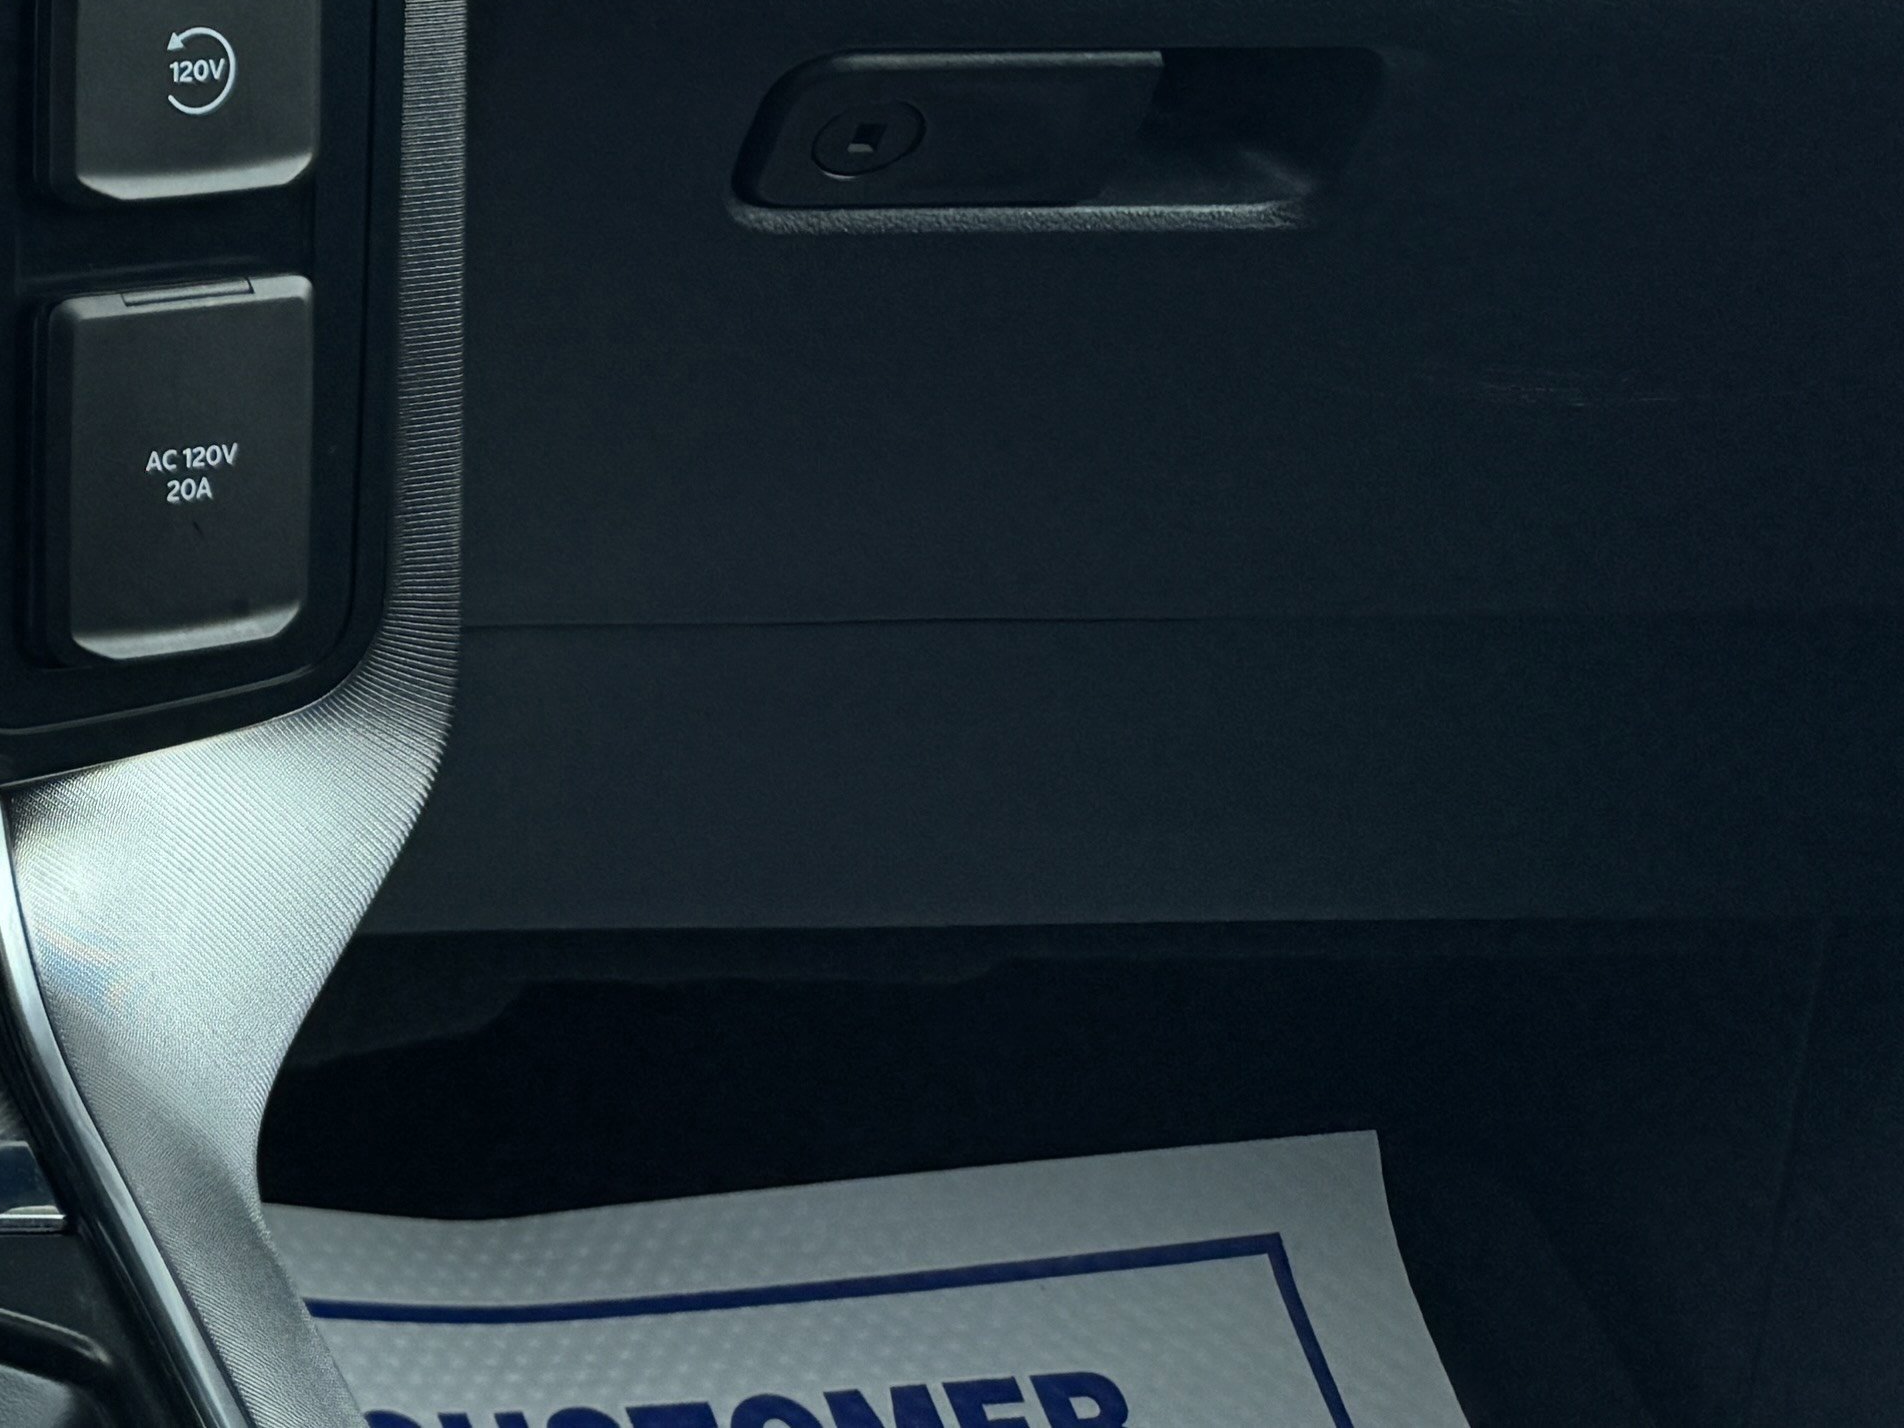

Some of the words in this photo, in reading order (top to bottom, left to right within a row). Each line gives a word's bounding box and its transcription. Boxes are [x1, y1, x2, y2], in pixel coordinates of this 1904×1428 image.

[169, 58, 225, 84] 120V
[146, 448, 178, 472] AC
[182, 442, 238, 470] 120V
[166, 476, 212, 503] 20A
